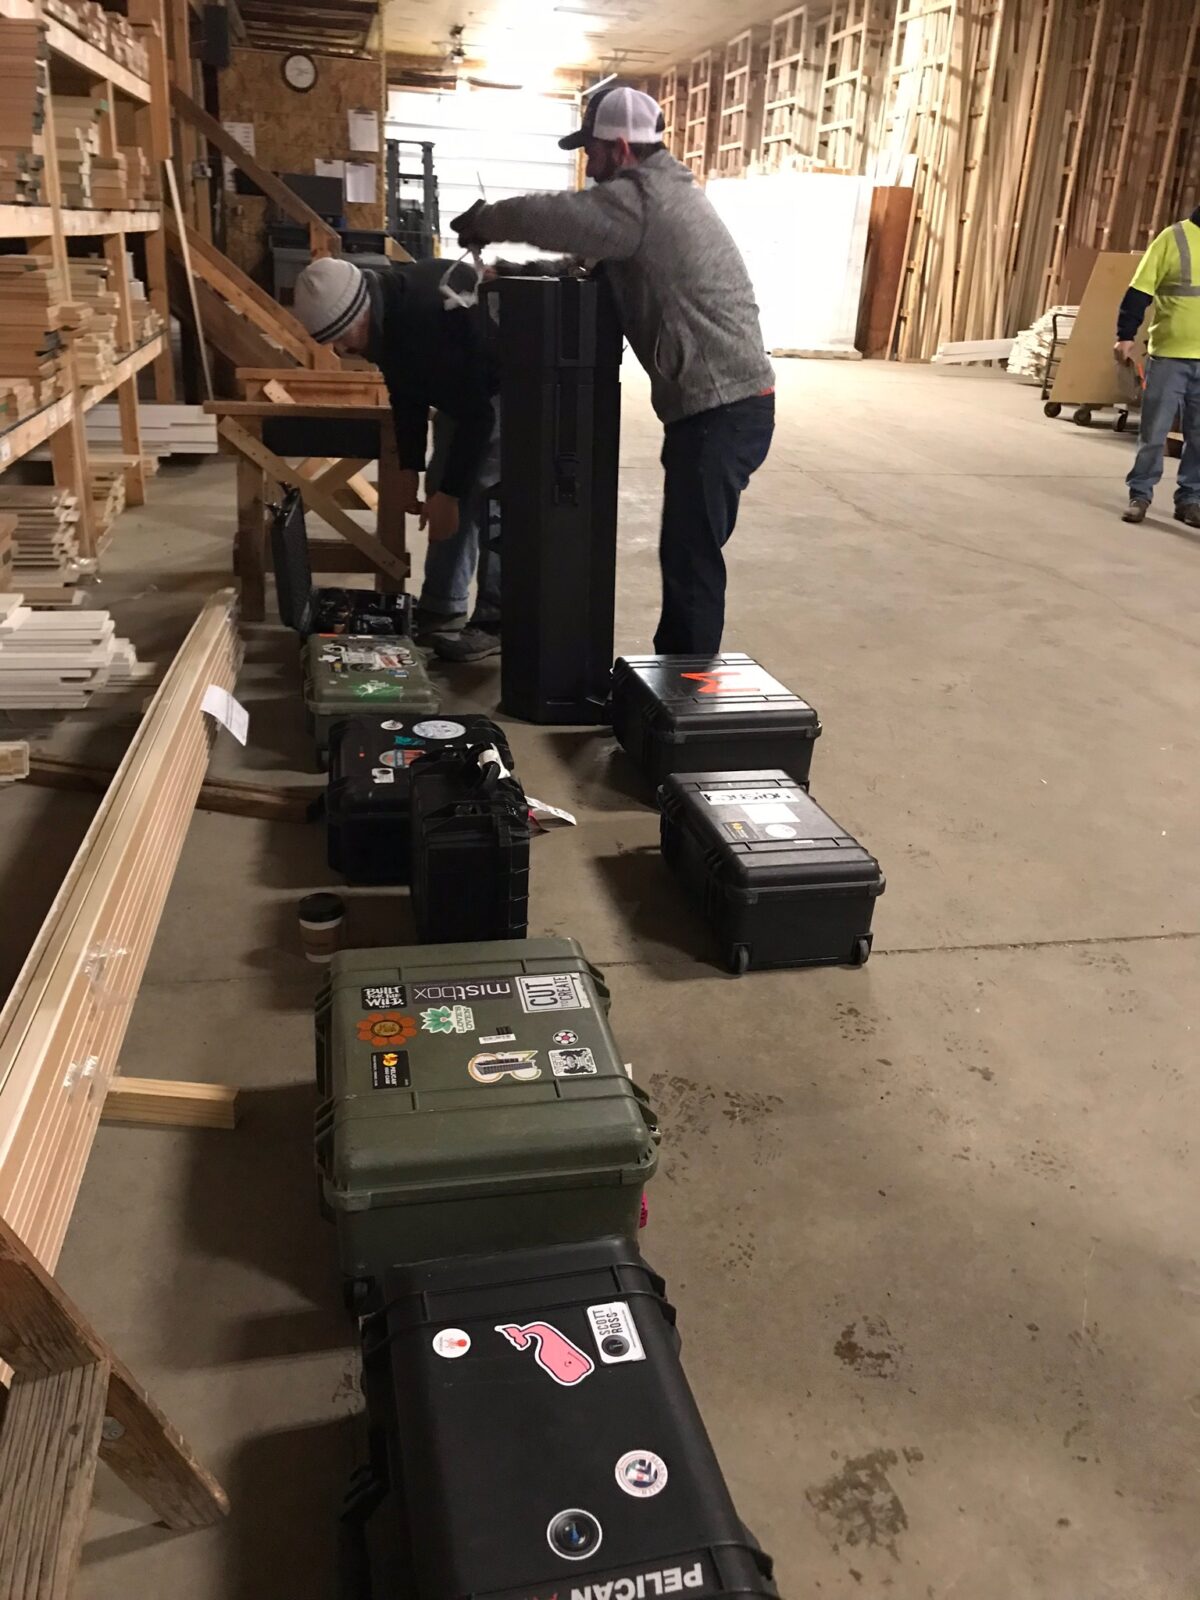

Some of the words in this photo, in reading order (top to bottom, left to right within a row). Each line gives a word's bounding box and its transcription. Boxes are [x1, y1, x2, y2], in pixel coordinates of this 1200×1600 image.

[363, 985, 403, 996] BUILT
[414, 983, 511, 1000] mistbox
[524, 983, 558, 1006] CUT
[553, 976, 573, 1001] CREATE
[463, 1008, 472, 1029] OVEN
[593, 1310, 610, 1335] SCOTT
[606, 1312, 623, 1334] ROSS
[571, 1562, 703, 1600] PELICAN
